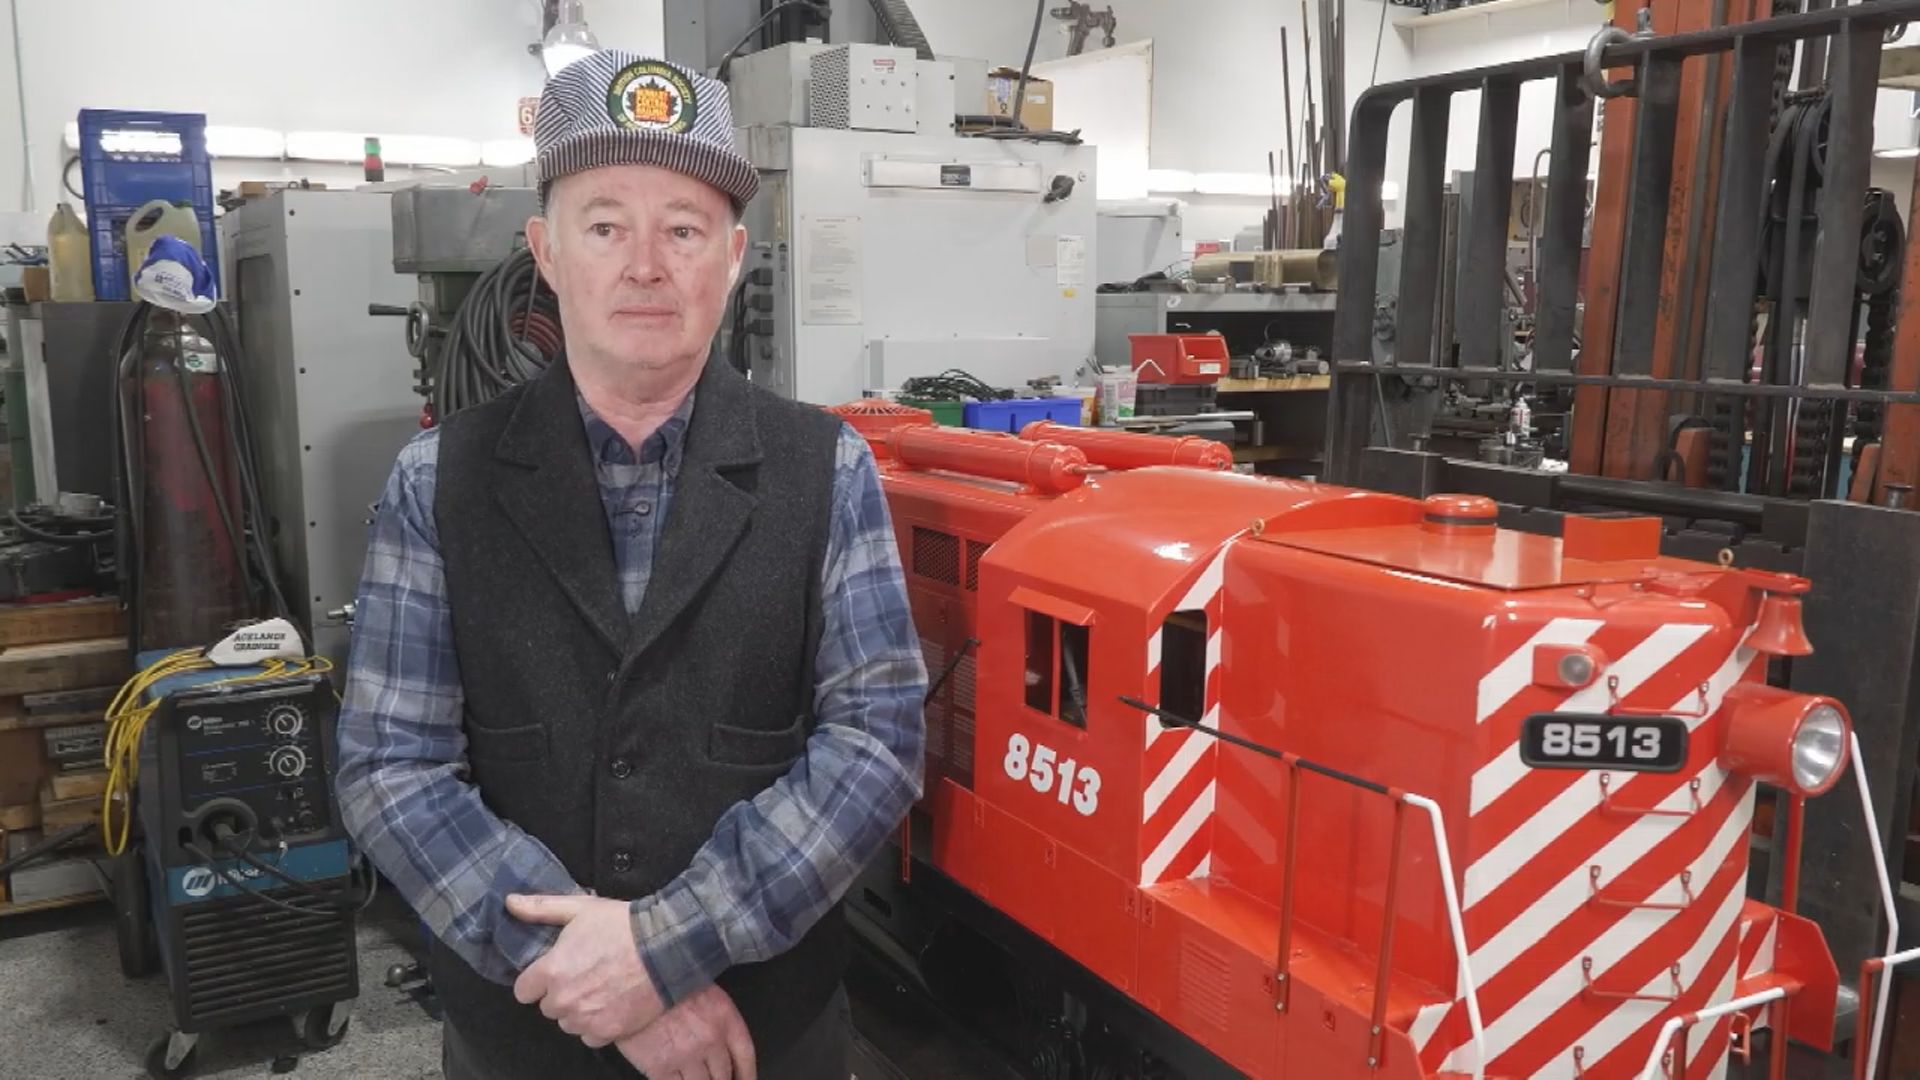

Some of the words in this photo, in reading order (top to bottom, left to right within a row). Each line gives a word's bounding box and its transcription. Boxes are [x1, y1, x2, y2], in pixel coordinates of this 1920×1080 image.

[634, 64, 672, 78] COLUMBIA
[672, 73, 692, 104] SOCIETY
[521, 106, 534, 124] 6
[233, 632, 286, 642] ACKLANDS
[233, 643, 281, 652] GRAINGER
[1542, 722, 1662, 759] 8513
[1003, 732, 1102, 817] 8513
